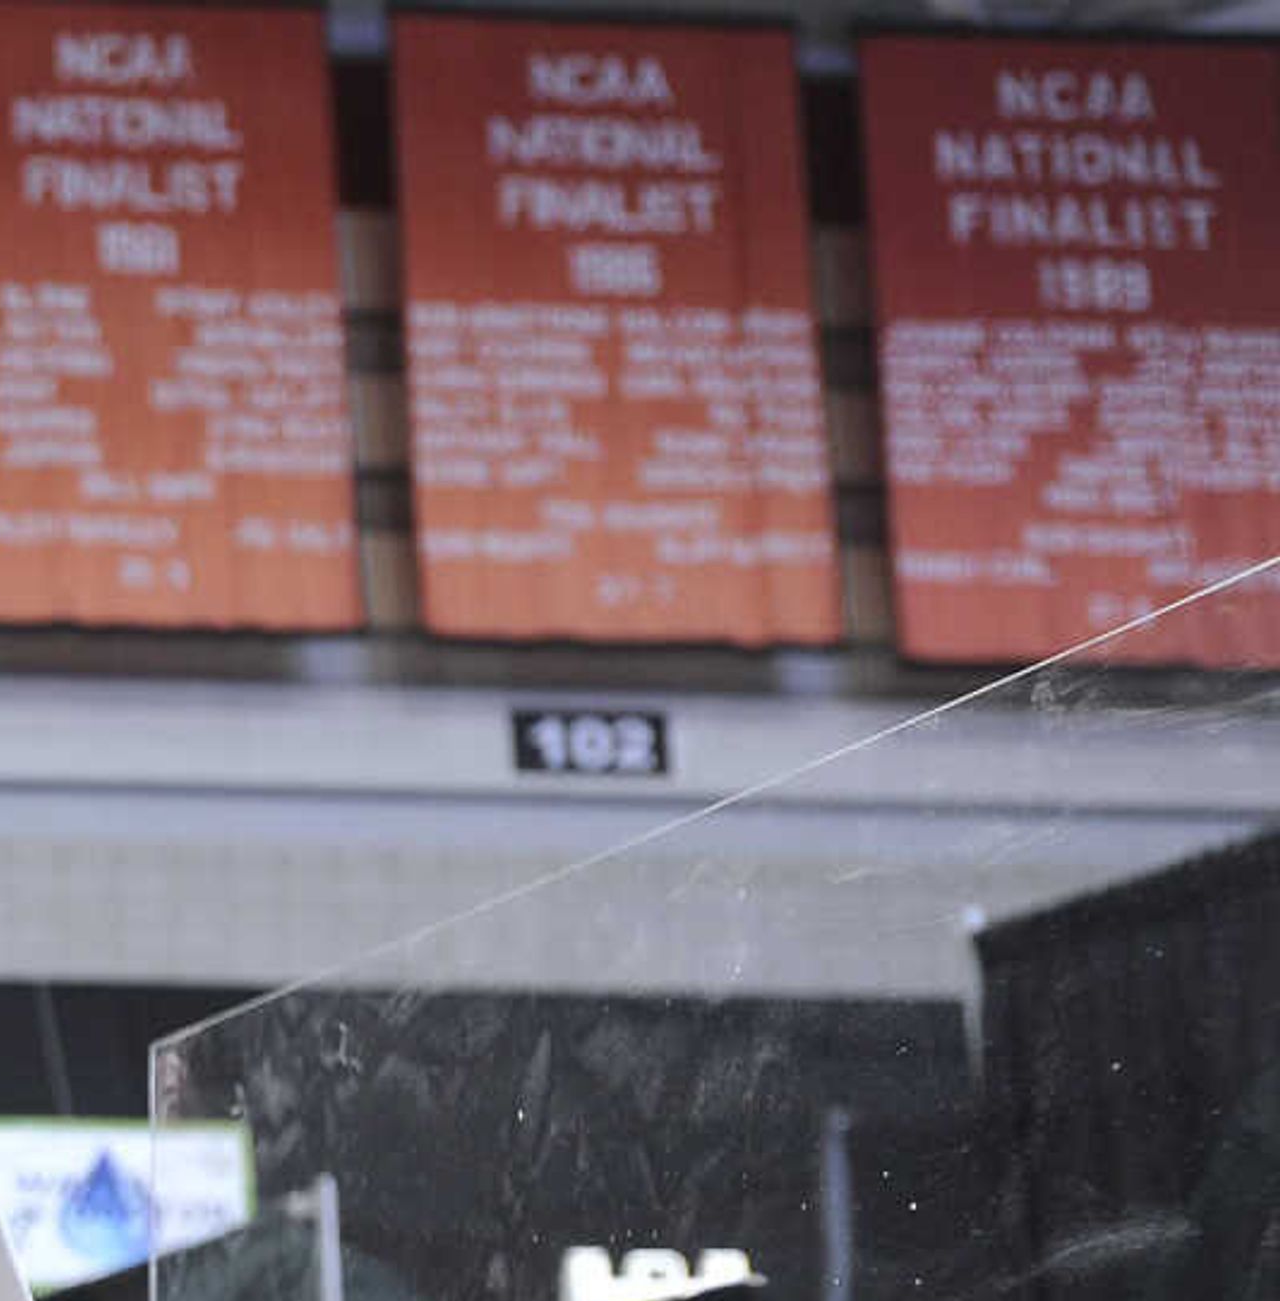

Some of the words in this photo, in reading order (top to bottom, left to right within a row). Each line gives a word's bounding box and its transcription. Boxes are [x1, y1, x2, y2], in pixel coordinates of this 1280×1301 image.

[528, 54, 675, 105] NCAA
[997, 69, 1153, 119] NCAA
[934, 131, 1220, 188] NATIONAL
[950, 193, 1216, 249] FINALIST
[529, 716, 657, 769] 102
